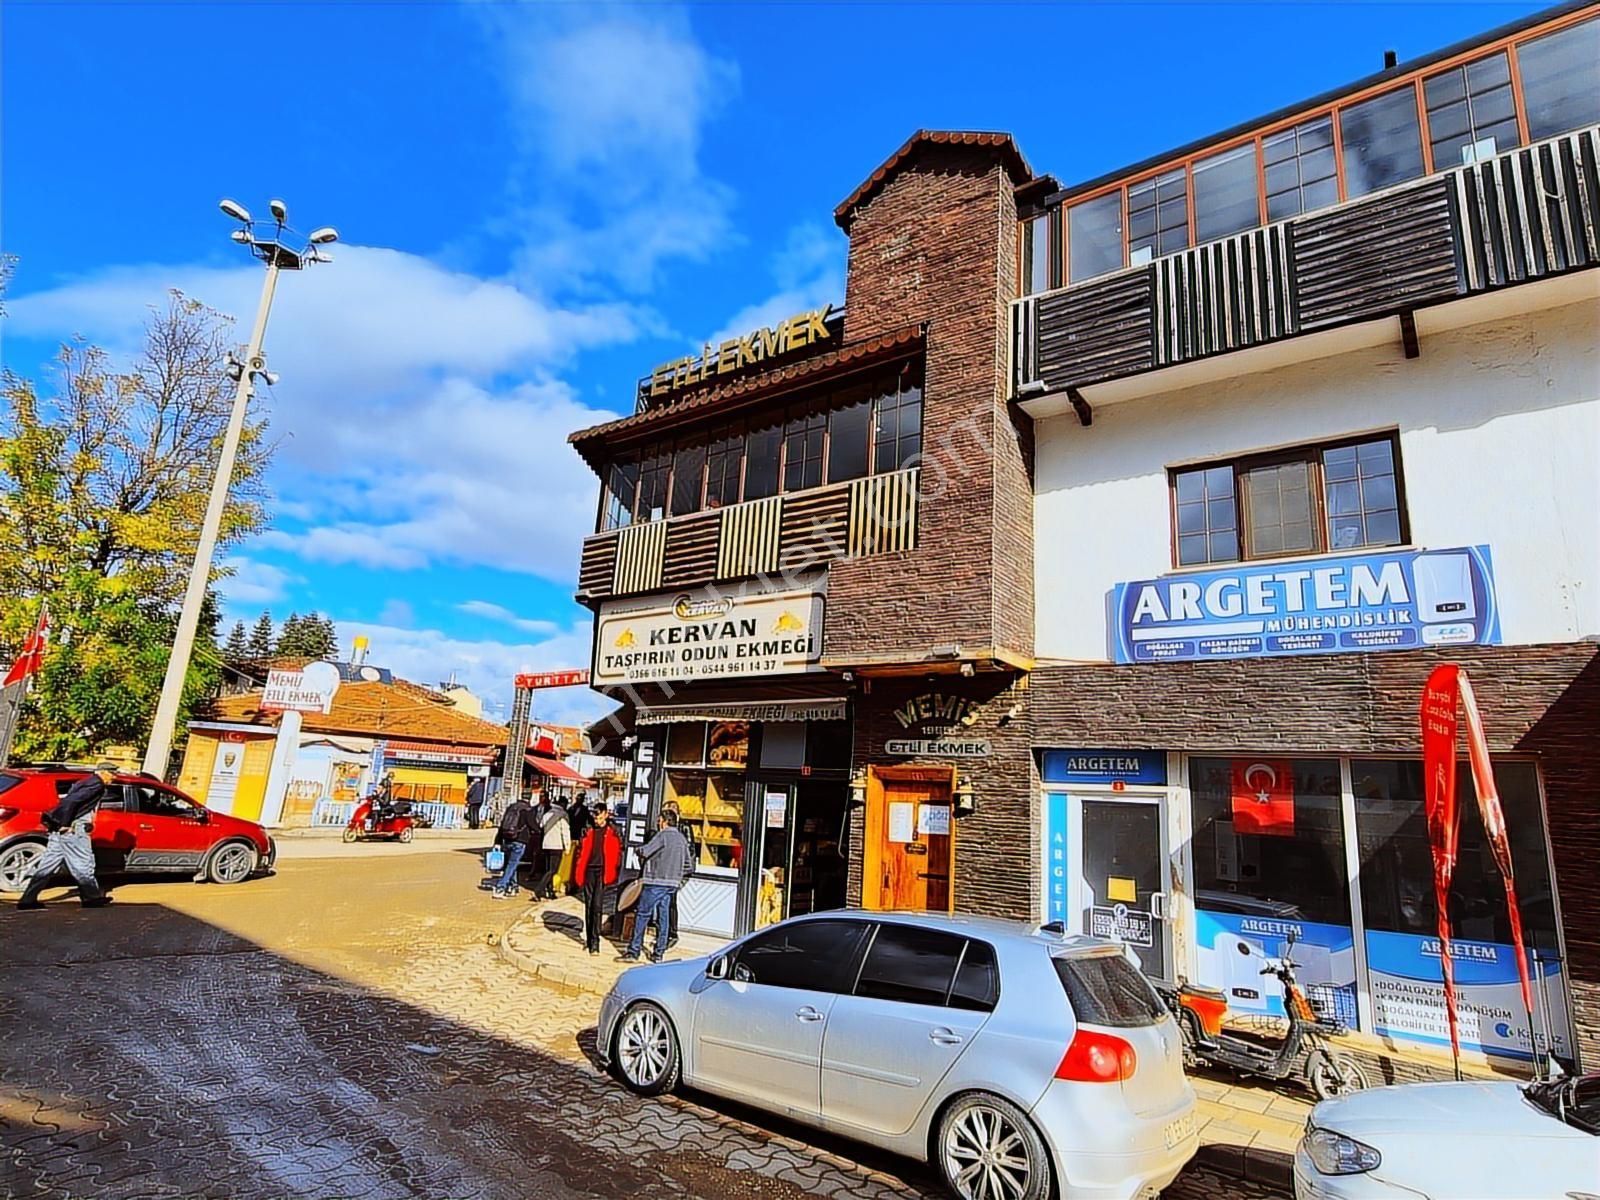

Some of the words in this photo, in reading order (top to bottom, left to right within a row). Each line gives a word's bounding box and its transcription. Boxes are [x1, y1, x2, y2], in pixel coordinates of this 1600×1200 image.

[650, 341, 716, 397] ETLİ
[717, 303, 832, 375] EKMEK
[1132, 559, 1411, 625] ARGETEM
[1267, 607, 1412, 633] MÜHENDİSLİK
[649, 618, 757, 646] KERVAN
[681, 645, 728, 663] ODUN
[736, 633, 814, 658] EKMEĞİ
[702, 664, 724, 674] 0544
[728, 662, 744, 672] 961
[749, 661, 760, 671] 14
[764, 660, 776, 670] 37
[288, 690, 321, 703] EKMEK
[889, 740, 922, 753] ETLİ
[927, 742, 987, 754] EKMEK
[1067, 757, 1140, 770] ARGETEM
[625, 741, 654, 870] EKMEK
[1240, 919, 1303, 935] ARGETEM
[1380, 981, 1434, 996] DOĞALGAZ
[1381, 993, 1414, 1004] KAZAN
[1457, 1003, 1512, 1020] DÖNÜŞÜM
[1382, 1005, 1436, 1020] DOĞALGAZ
